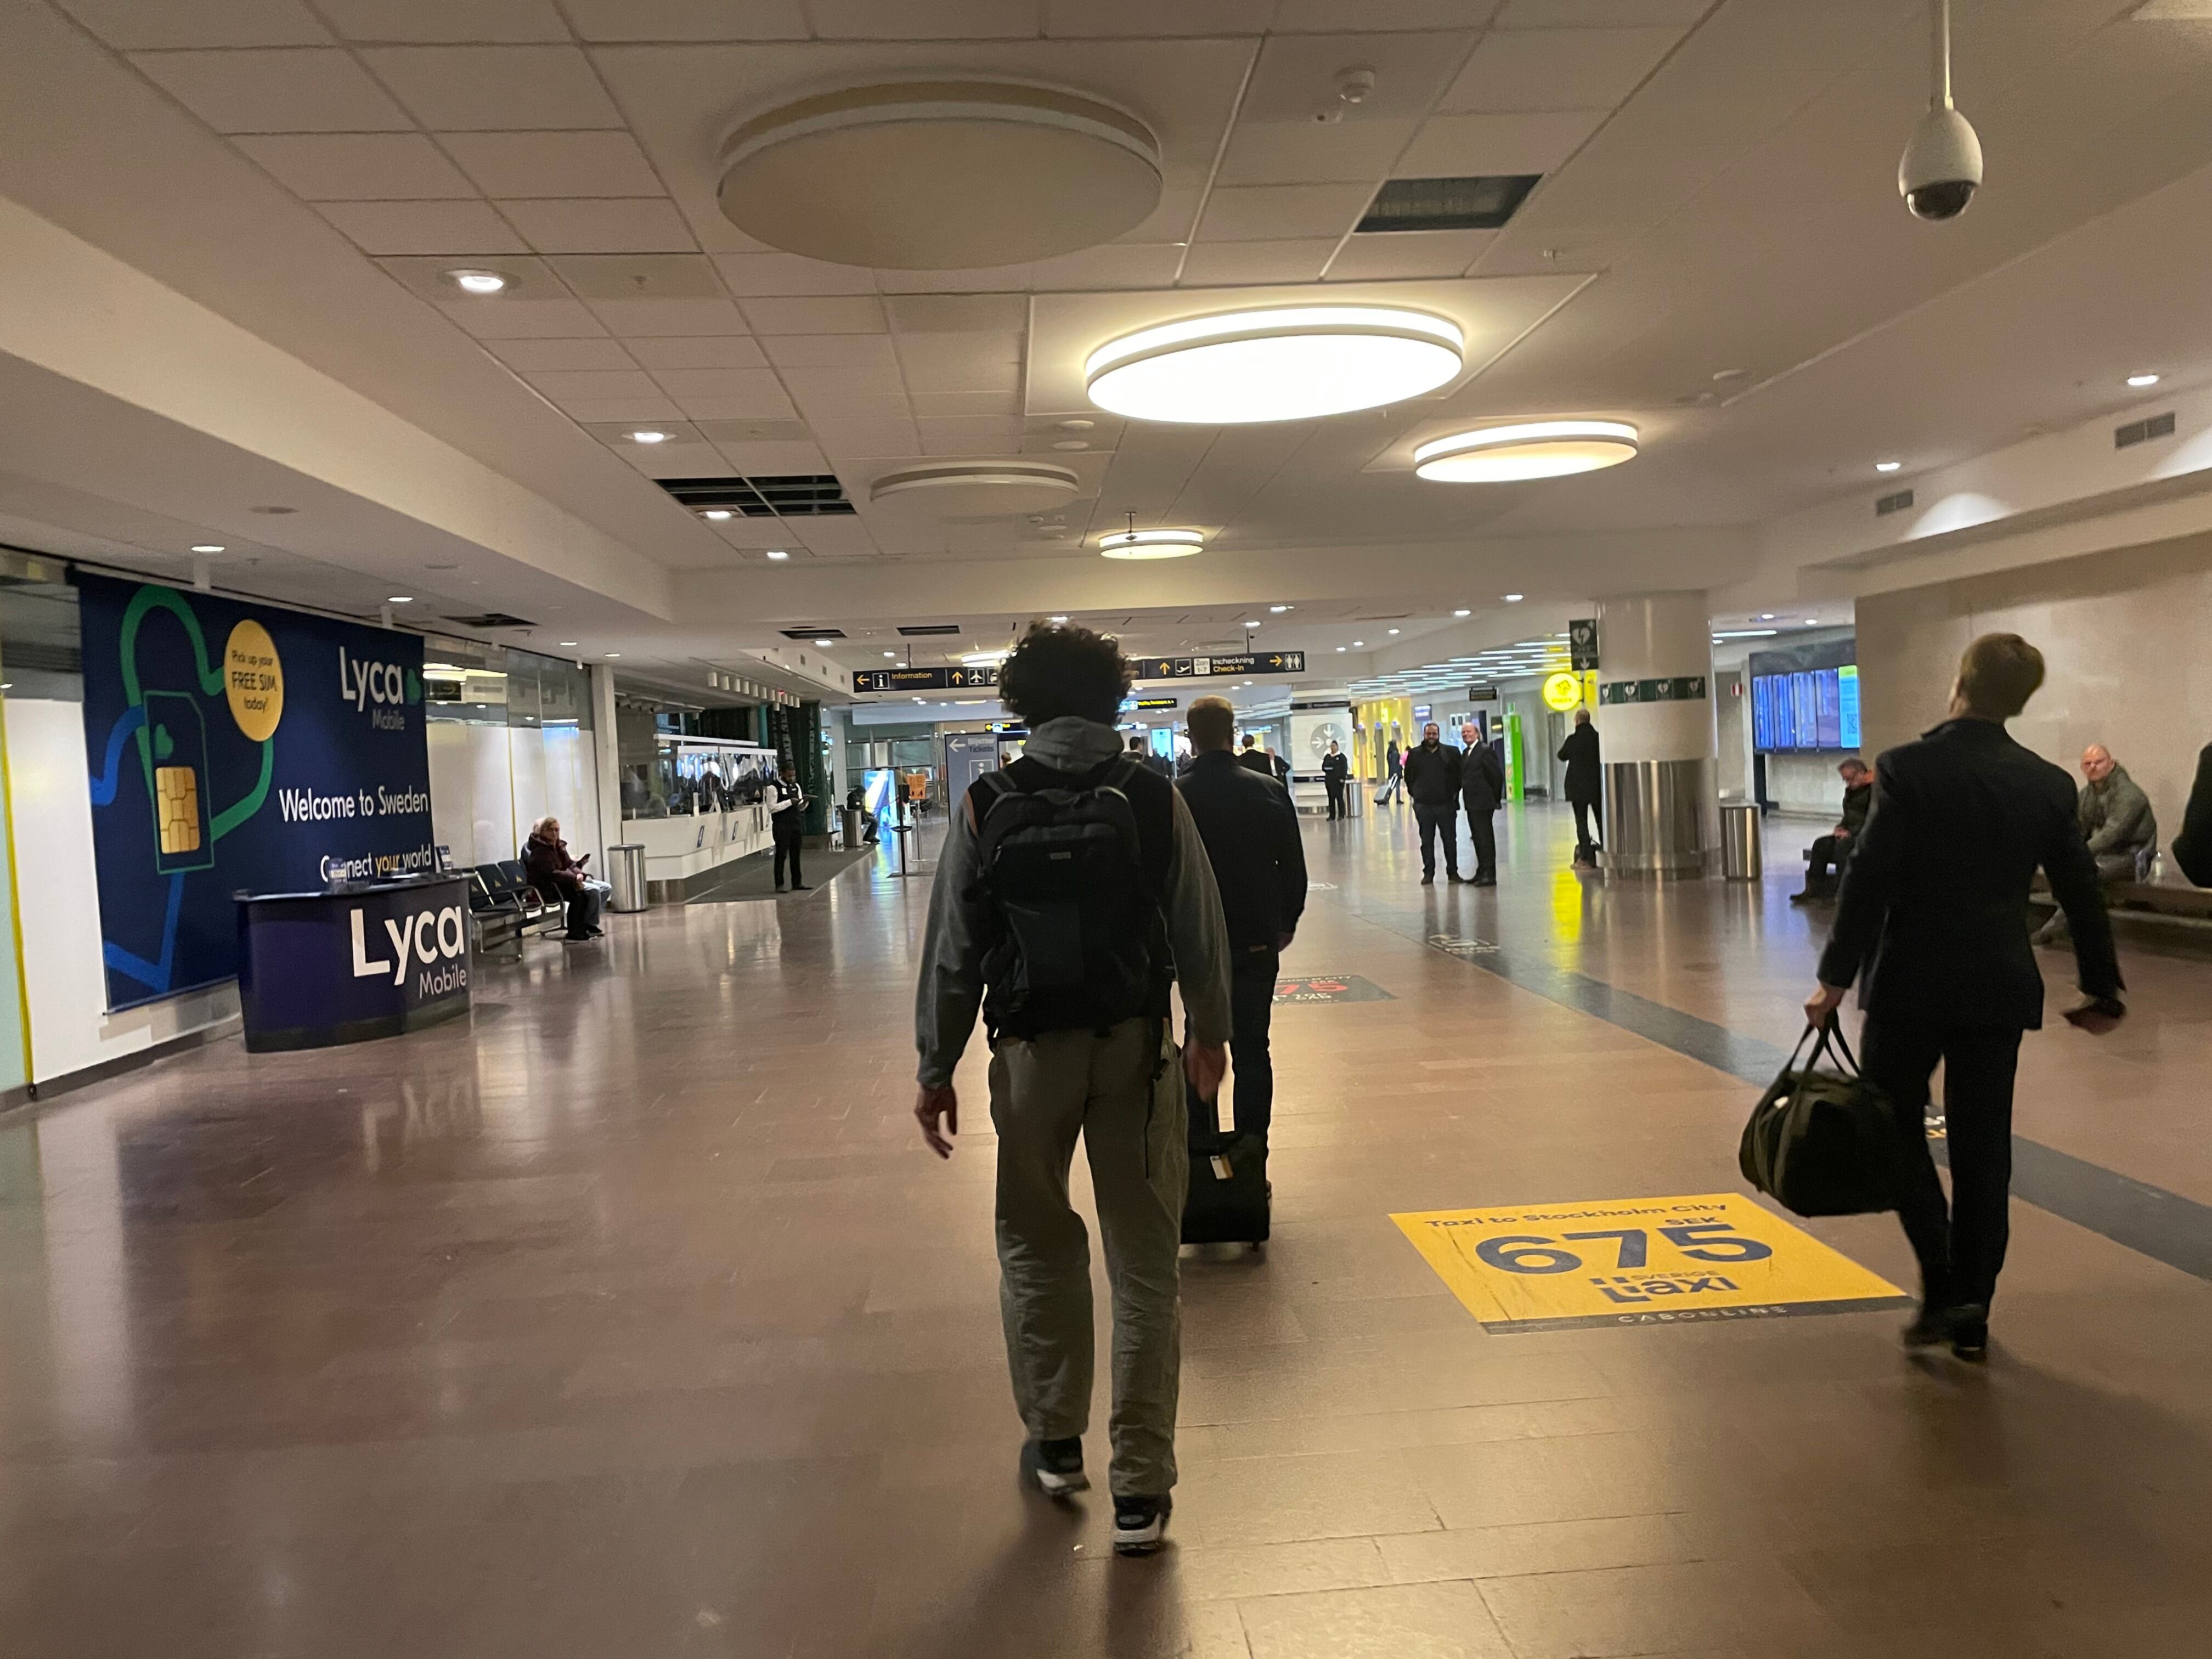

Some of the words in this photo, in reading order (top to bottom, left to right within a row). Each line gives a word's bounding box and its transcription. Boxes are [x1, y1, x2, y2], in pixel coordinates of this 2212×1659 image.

[1212, 656, 1255, 665] Incheckning
[232, 671, 257, 690] FREE
[259, 674, 278, 691] SIM
[339, 646, 404, 712] Lyca
[372, 708, 405, 731] Mobile
[278, 787, 355, 822] Welcome
[359, 788, 374, 816] to
[378, 785, 428, 816] Sweden
[320, 852, 373, 883] Cnect
[375, 854, 400, 878] your
[403, 843, 432, 873] world
[350, 906, 465, 986] Lyca
[419, 963, 466, 1000] Mobile
[1424, 1217, 1484, 1227] Taxi
[1522, 1208, 1667, 1221] Stockholm
[1665, 1216, 1723, 1225] SEK
[1475, 1223, 1773, 1274] 675
[1618, 1306, 1788, 1322] CABONLINE
